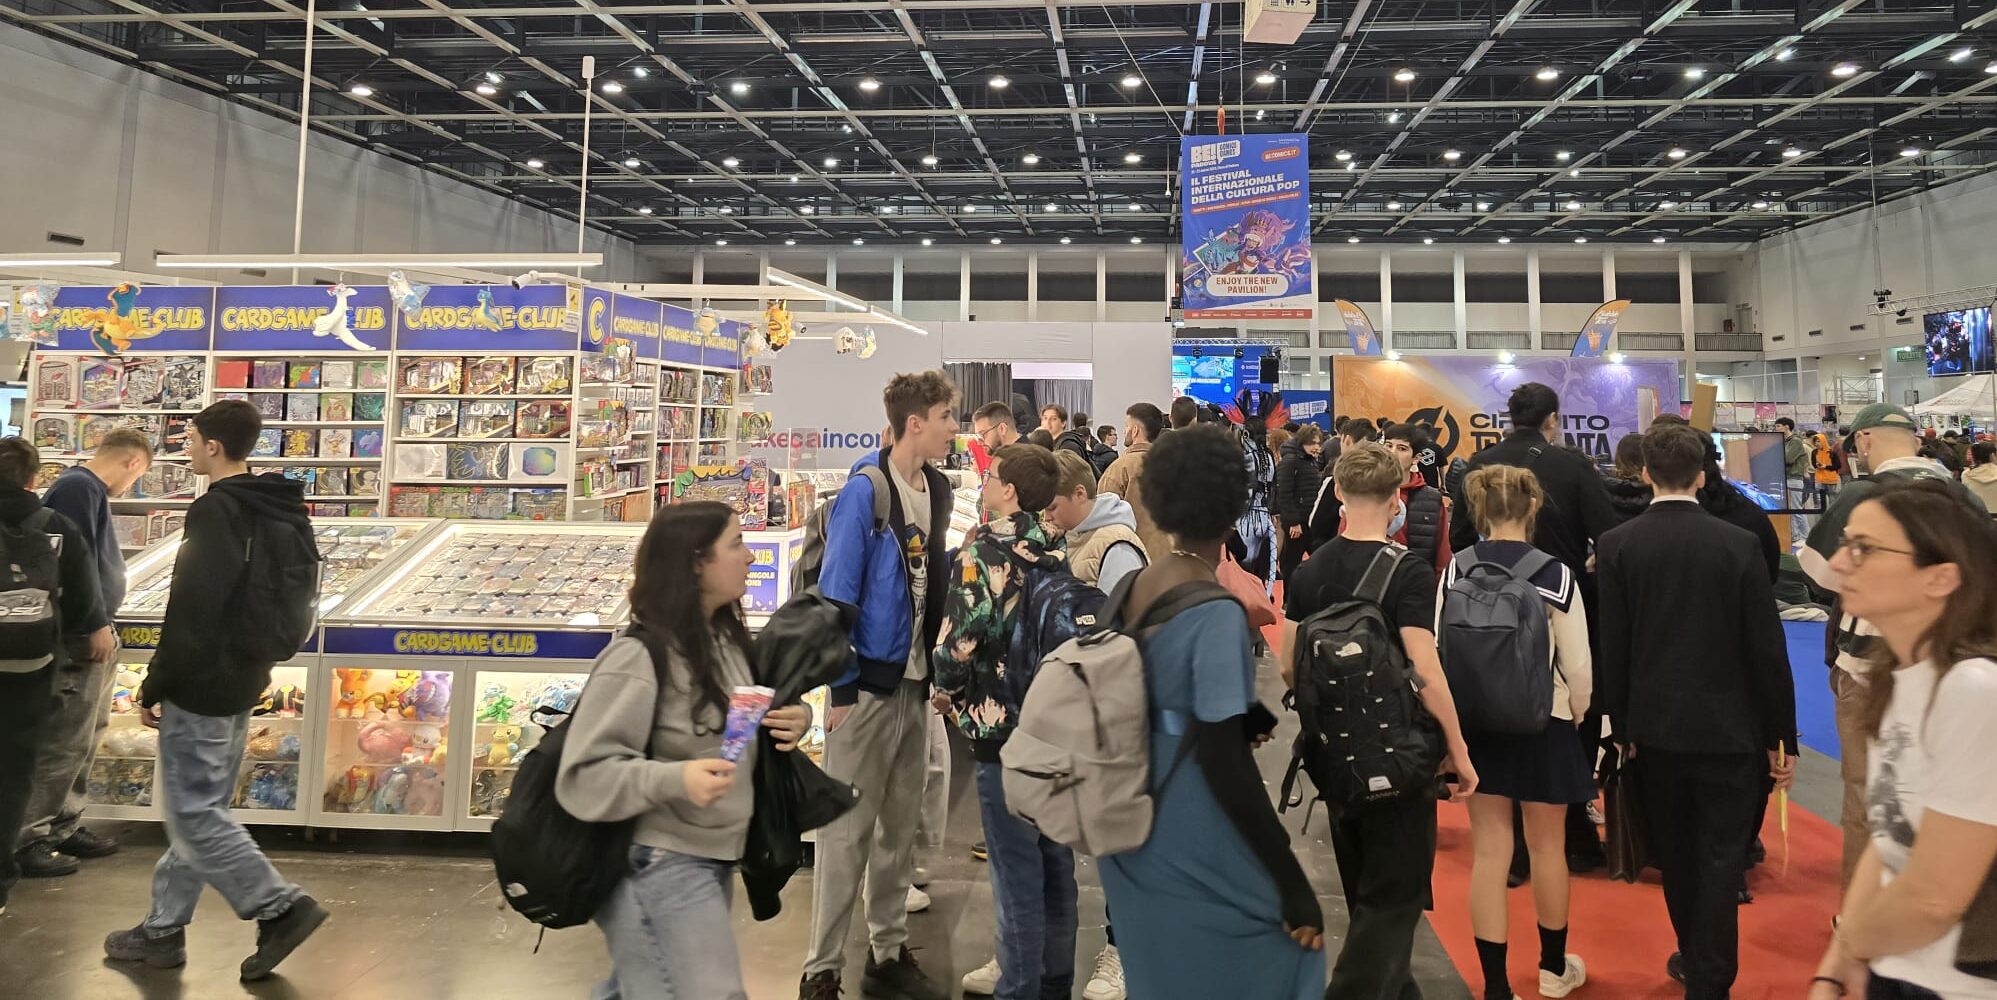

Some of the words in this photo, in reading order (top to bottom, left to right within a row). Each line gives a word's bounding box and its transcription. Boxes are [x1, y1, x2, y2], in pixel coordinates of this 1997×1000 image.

[1191, 177, 1200, 186] IL
[1202, 169, 1251, 184] FESTIVAL
[1191, 173, 1284, 196] INTERNAZIONALE
[1191, 191, 1224, 205] DELLA
[1225, 185, 1276, 198] CULTURA
[1277, 180, 1300, 191] POP
[1216, 277, 1242, 285] ENJOY
[1243, 277, 1260, 285] THE
[1227, 285, 1267, 294] PAVILION!
[588, 298, 608, 345] C
[394, 631, 538, 655] CARDGAME-CLUB
